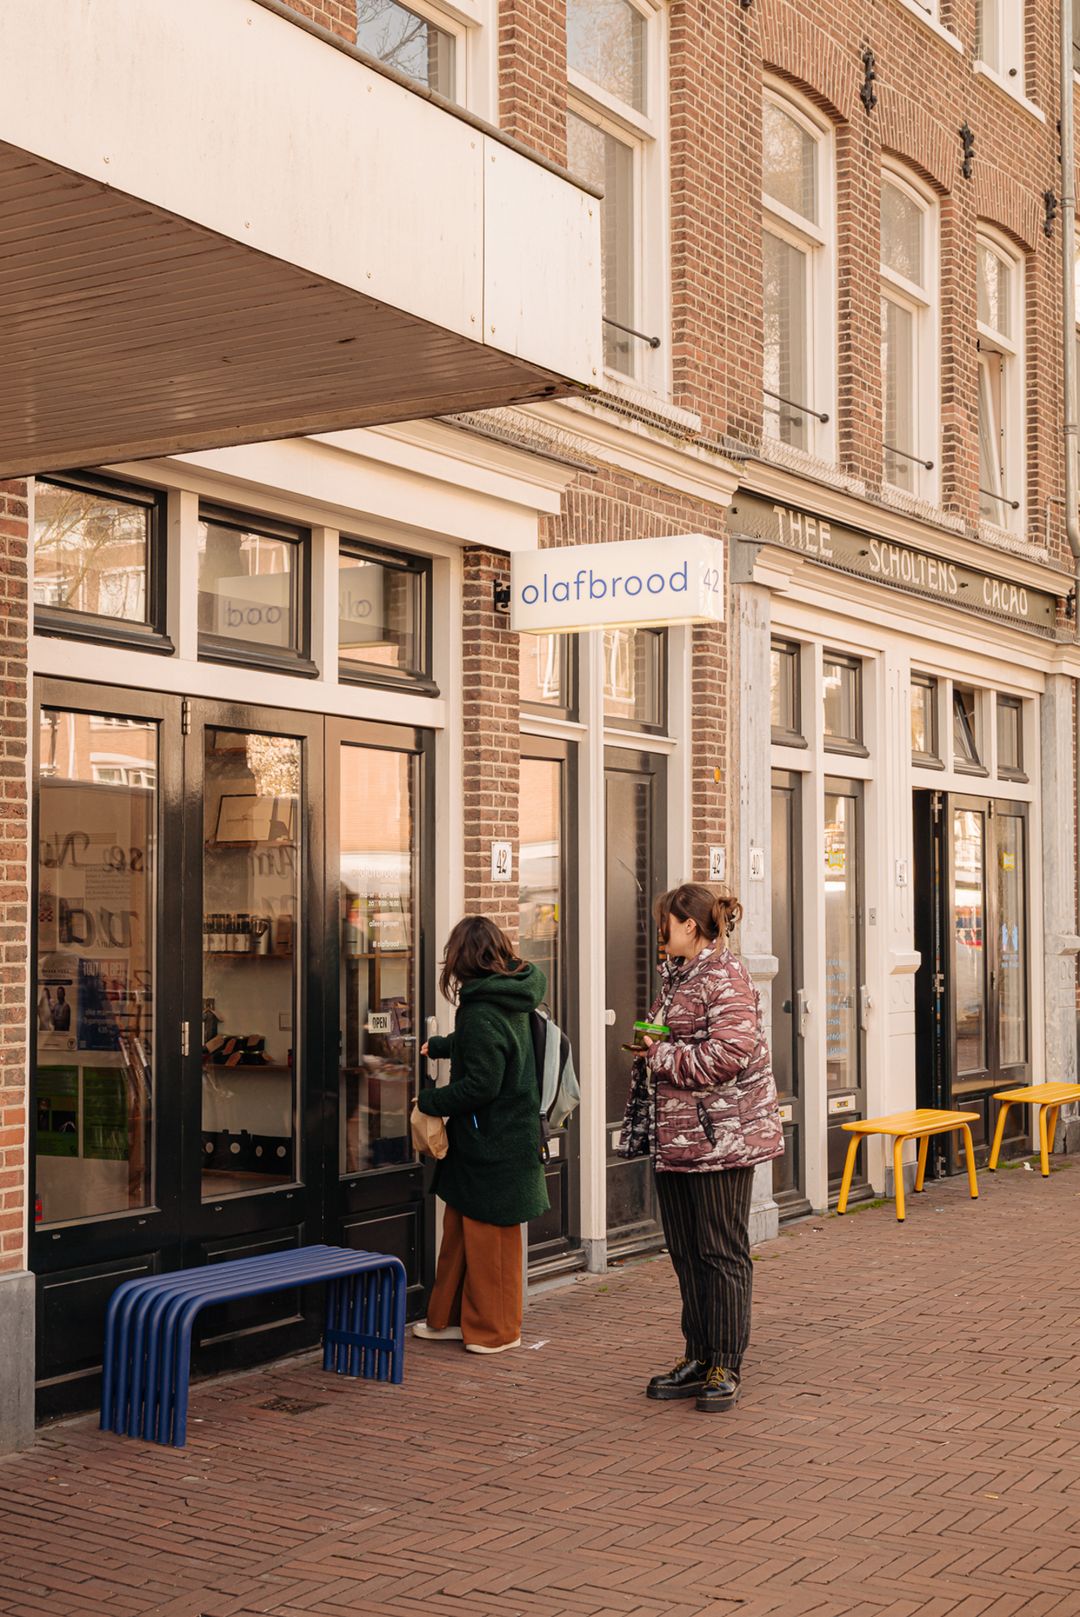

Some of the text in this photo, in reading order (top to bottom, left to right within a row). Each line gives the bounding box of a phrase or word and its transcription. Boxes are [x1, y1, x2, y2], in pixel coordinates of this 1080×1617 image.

[773, 505, 1028, 616] THEE SCHOLTENS CACAO
[521, 560, 688, 604] olafbrood
[703, 568, 720, 593] 42
[496, 849, 508, 874] 42
[712, 853, 721, 875] 42
[372, 1016, 388, 1029] OPEN
